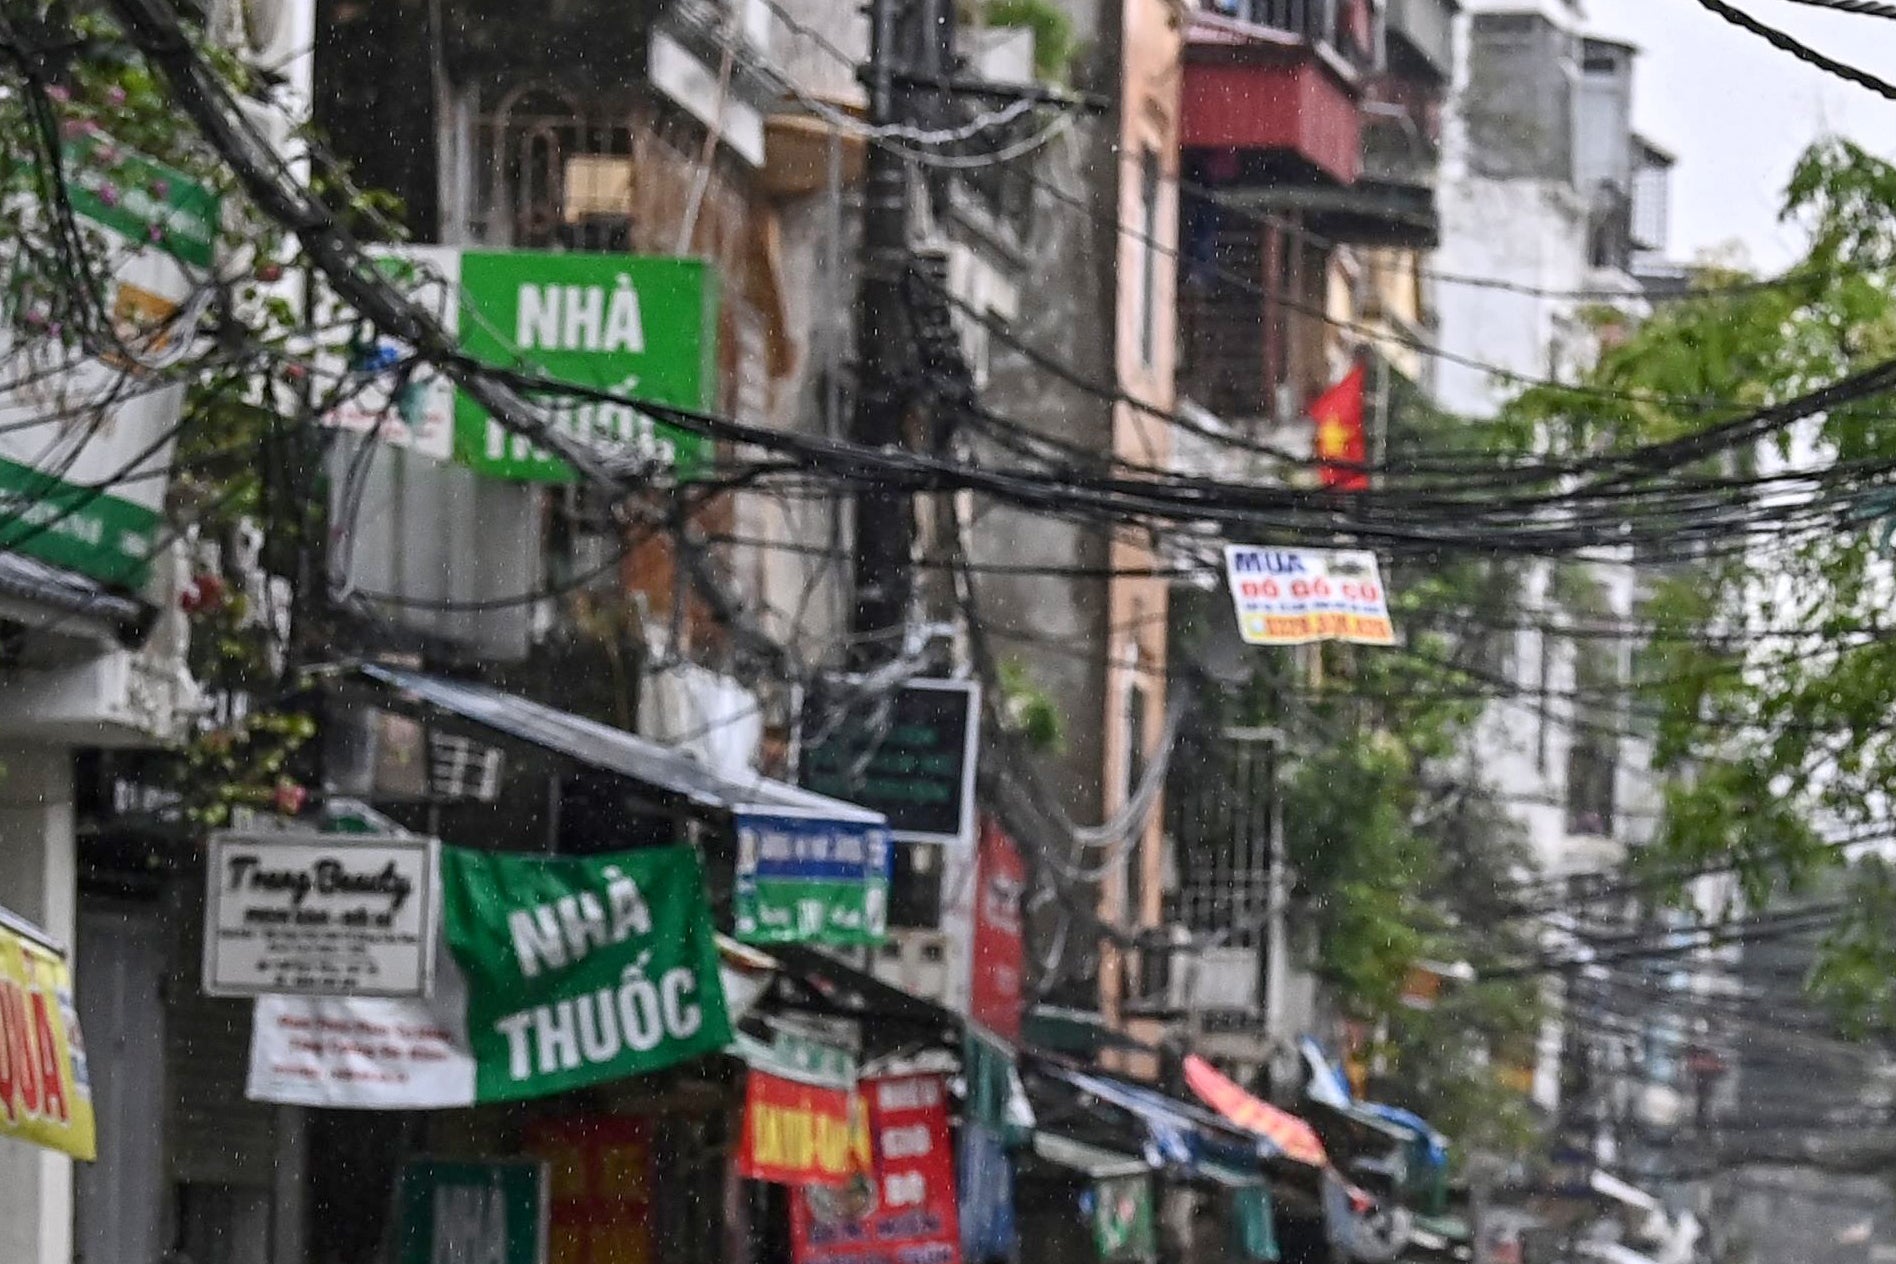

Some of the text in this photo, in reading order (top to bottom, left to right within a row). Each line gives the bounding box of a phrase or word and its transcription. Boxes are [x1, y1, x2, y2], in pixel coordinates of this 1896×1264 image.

[517, 272, 645, 353] NHÀ
[507, 865, 652, 977] NHÀ
[494, 948, 702, 1082] THUỐC
